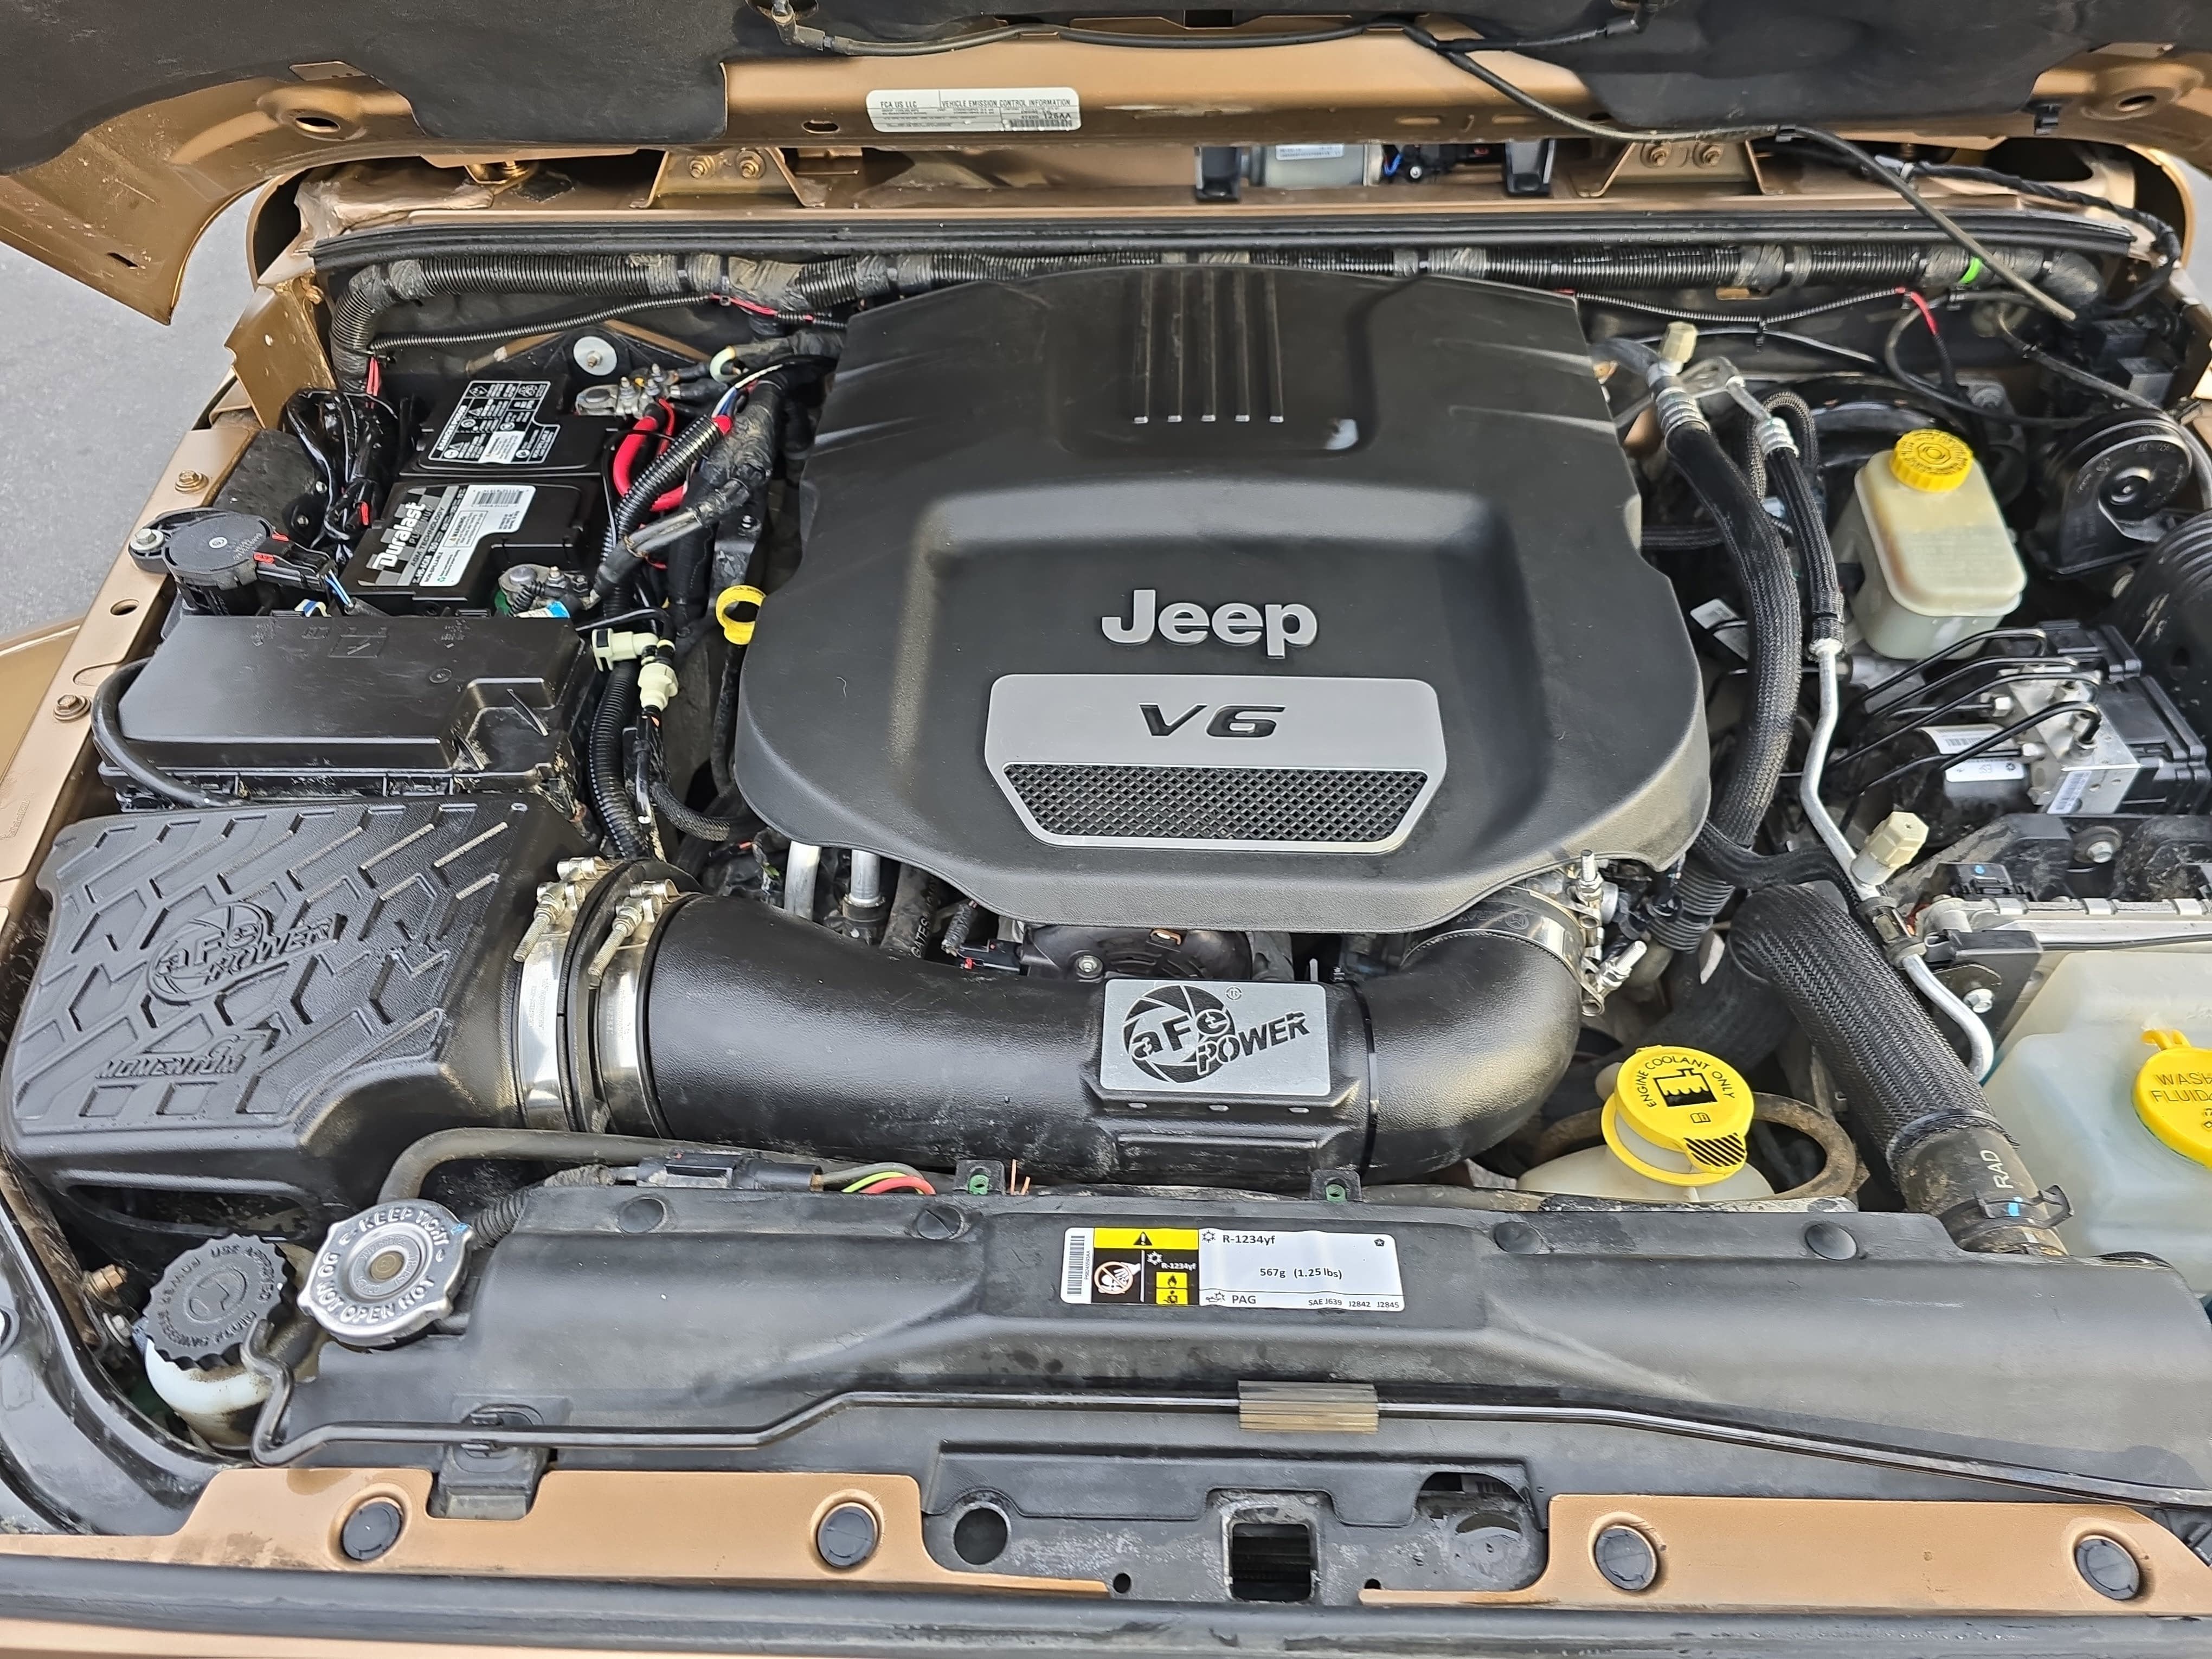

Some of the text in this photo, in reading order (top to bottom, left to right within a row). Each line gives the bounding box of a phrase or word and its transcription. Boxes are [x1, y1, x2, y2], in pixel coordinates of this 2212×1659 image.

[1028, 99, 1071, 107] INFORMATION
[372, 501, 427, 569] Duralast
[410, 506, 446, 567] AGM TECHNOLOGY
[1101, 589, 1318, 659] Jeep
[1139, 702, 1287, 739] V6
[910, 918, 929, 959] GATES
[1197, 1011, 1311, 1076] POWER
[95, 1056, 247, 1078] MOMENTUM
[1636, 1056, 1735, 1107] ENGINE COOLANT ONLY
[2151, 1090, 2209, 1102] FLUID
[1980, 1150, 2014, 1188] RAD
[358, 1207, 414, 1232] KEEP
[1222, 1234, 1276, 1245] R-1234yf
[1161, 1262, 1197, 1271] R-1234yf
[1259, 1268, 1342, 1279] 567g (1.25 lbs)
[317, 1280, 344, 1313] NOT
[340, 1303, 395, 1324] OPEN
[398, 1275, 434, 1309] HOT
[1231, 1294, 1257, 1304] PAG
